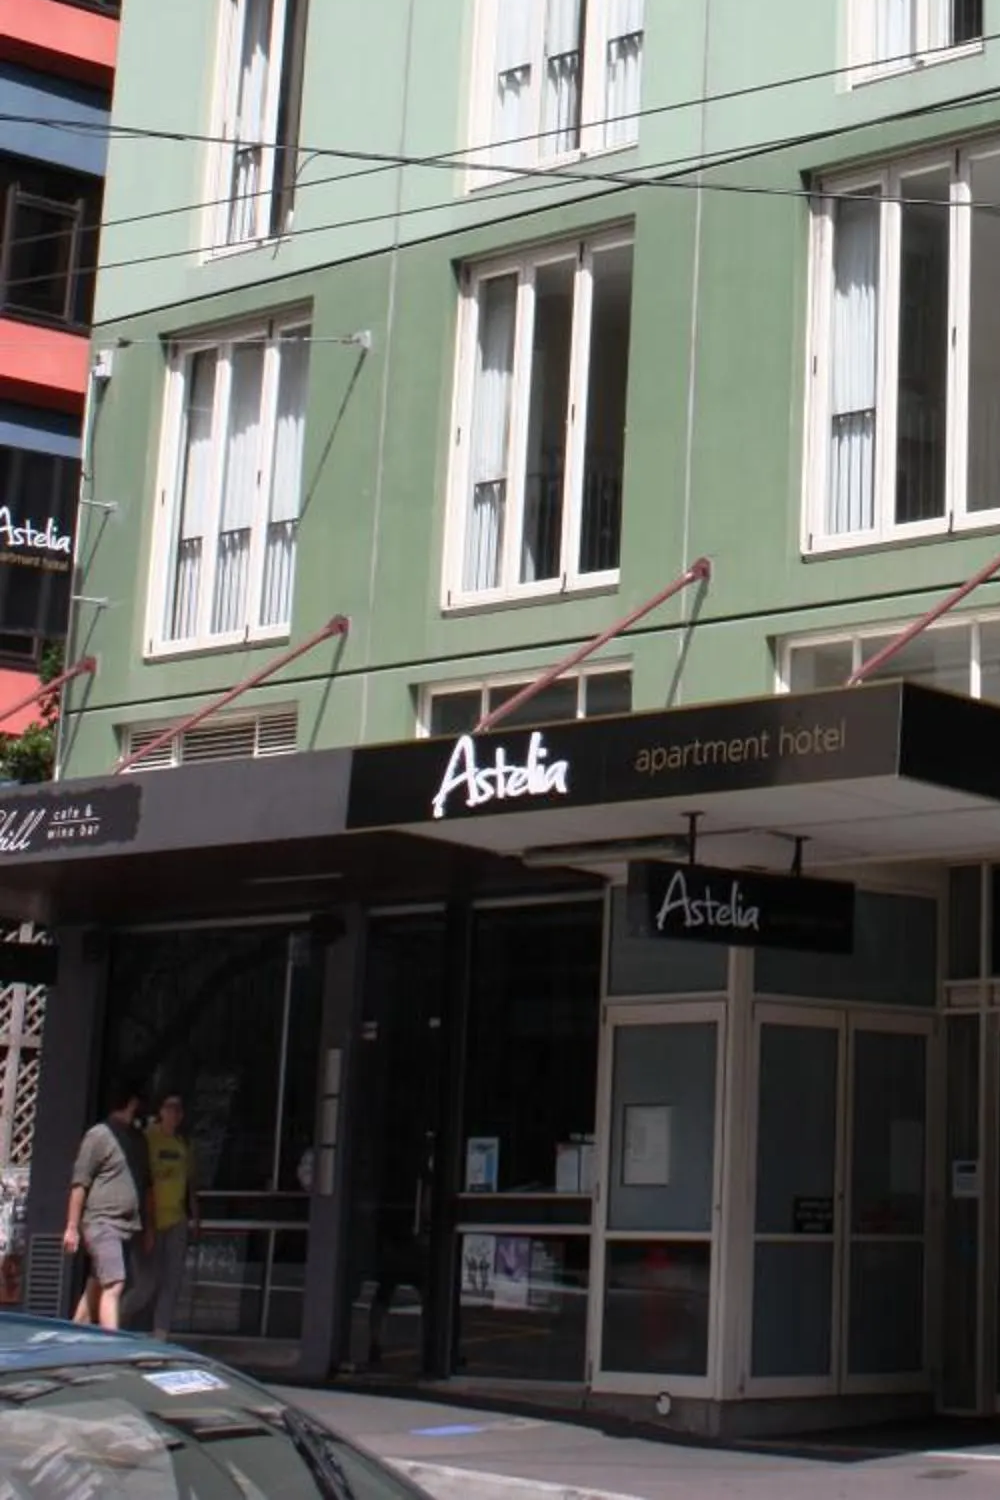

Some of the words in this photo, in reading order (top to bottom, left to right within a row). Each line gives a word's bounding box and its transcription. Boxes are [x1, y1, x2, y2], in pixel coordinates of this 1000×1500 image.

[432, 731, 569, 818] Astelia
[634, 729, 770, 777] apartment
[778, 718, 847, 756] hotel
[47, 826, 76, 839] wine
[80, 823, 100, 837] bar
[53, 806, 80, 821] cafe
[656, 869, 760, 931] Astelia
